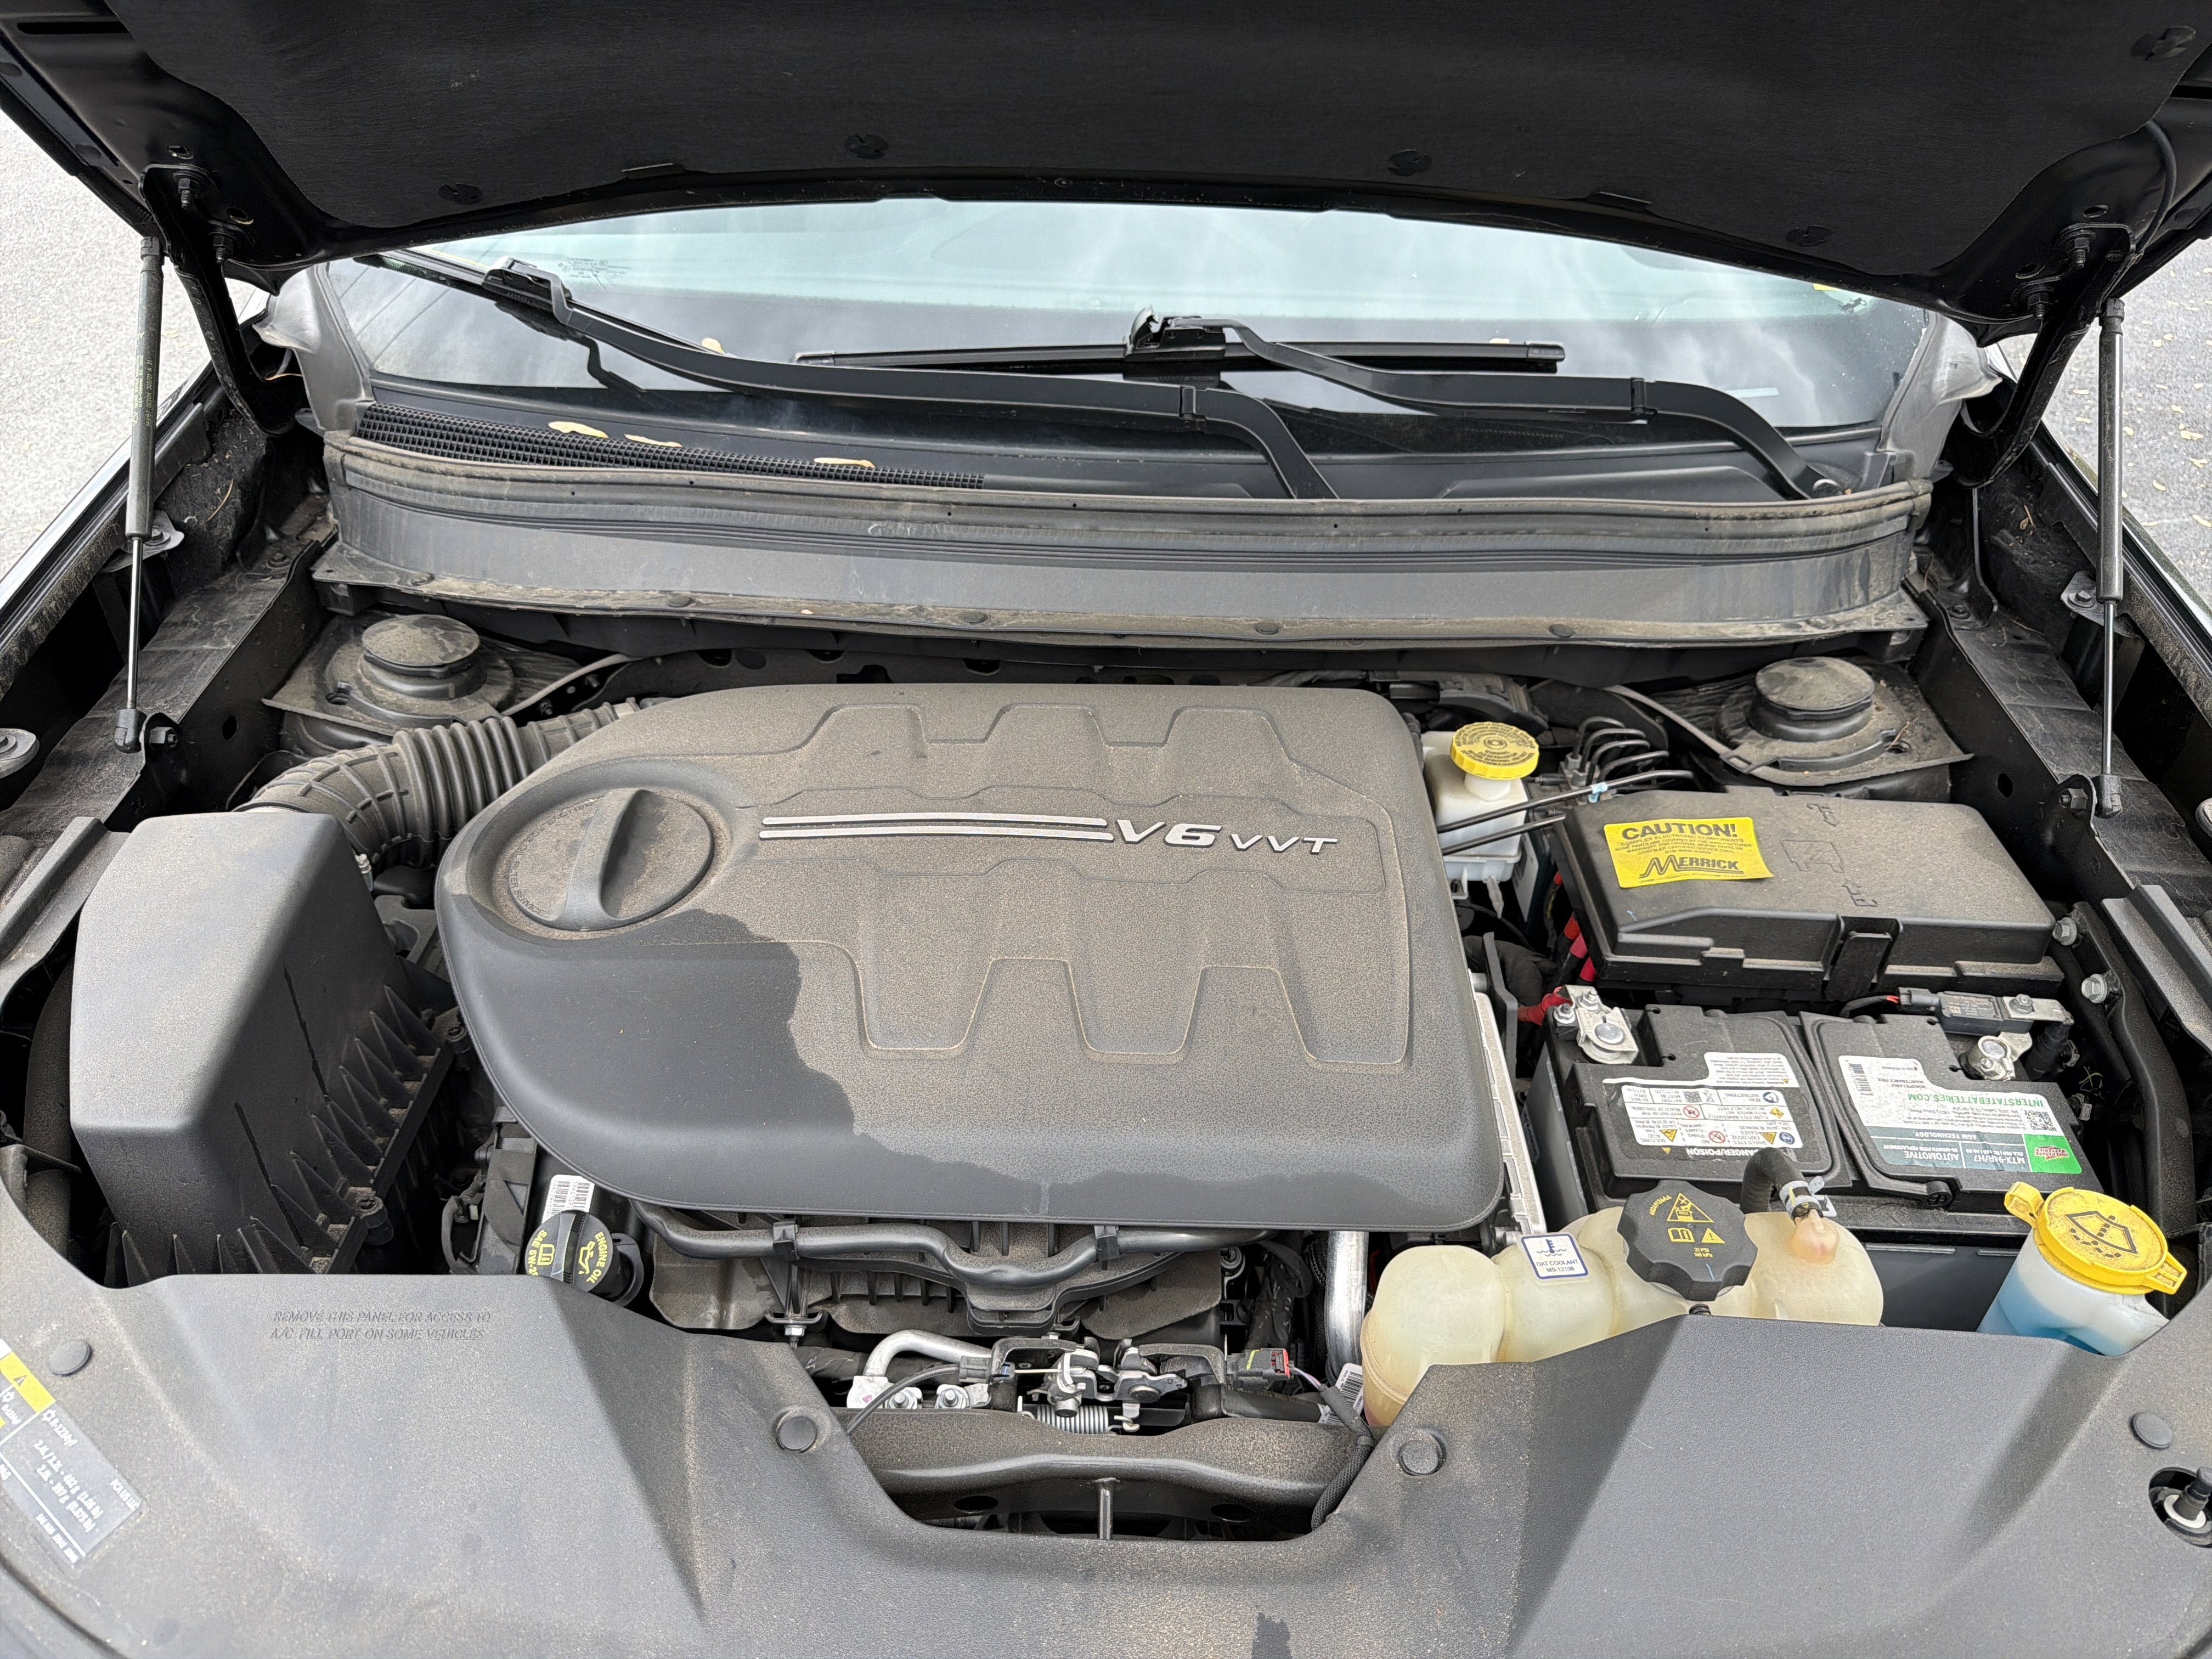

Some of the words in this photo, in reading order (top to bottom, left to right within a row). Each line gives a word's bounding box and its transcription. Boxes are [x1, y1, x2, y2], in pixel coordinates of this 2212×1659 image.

[1116, 819, 1223, 848] V6
[1231, 833, 1338, 854] VVT
[1621, 822, 1738, 840] CAUTION!
[1639, 854, 1740, 878] MERRICK
[1908, 1093, 2043, 1107] INTERSTATEBATTERIES.COM
[1904, 1151, 1959, 1160] AUTOMOTIVE
[1973, 1154, 2025, 1164] MTX-94R/H7
[532, 1229, 548, 1249] SAE
[594, 1232, 607, 1268] ENGINE
[585, 1268, 602, 1284] OIL
[274, 1311, 324, 1323] REMOVE
[328, 1311, 356, 1323] THIS
[358, 1311, 394, 1323] PANEL
[398, 1311, 422, 1323] FOR
[424, 1311, 472, 1323] ACCESS
[476, 1311, 491, 1323] TO
[270, 1327, 294, 1340] A/C
[298, 1328, 323, 1340] FILL
[329, 1328, 360, 1340] PORT
[364, 1328, 383, 1340] ON
[386, 1328, 422, 1340] SOME
[426, 1328, 485, 1340] VEHICLES
[49, 1418, 78, 1448] R-1234yf
